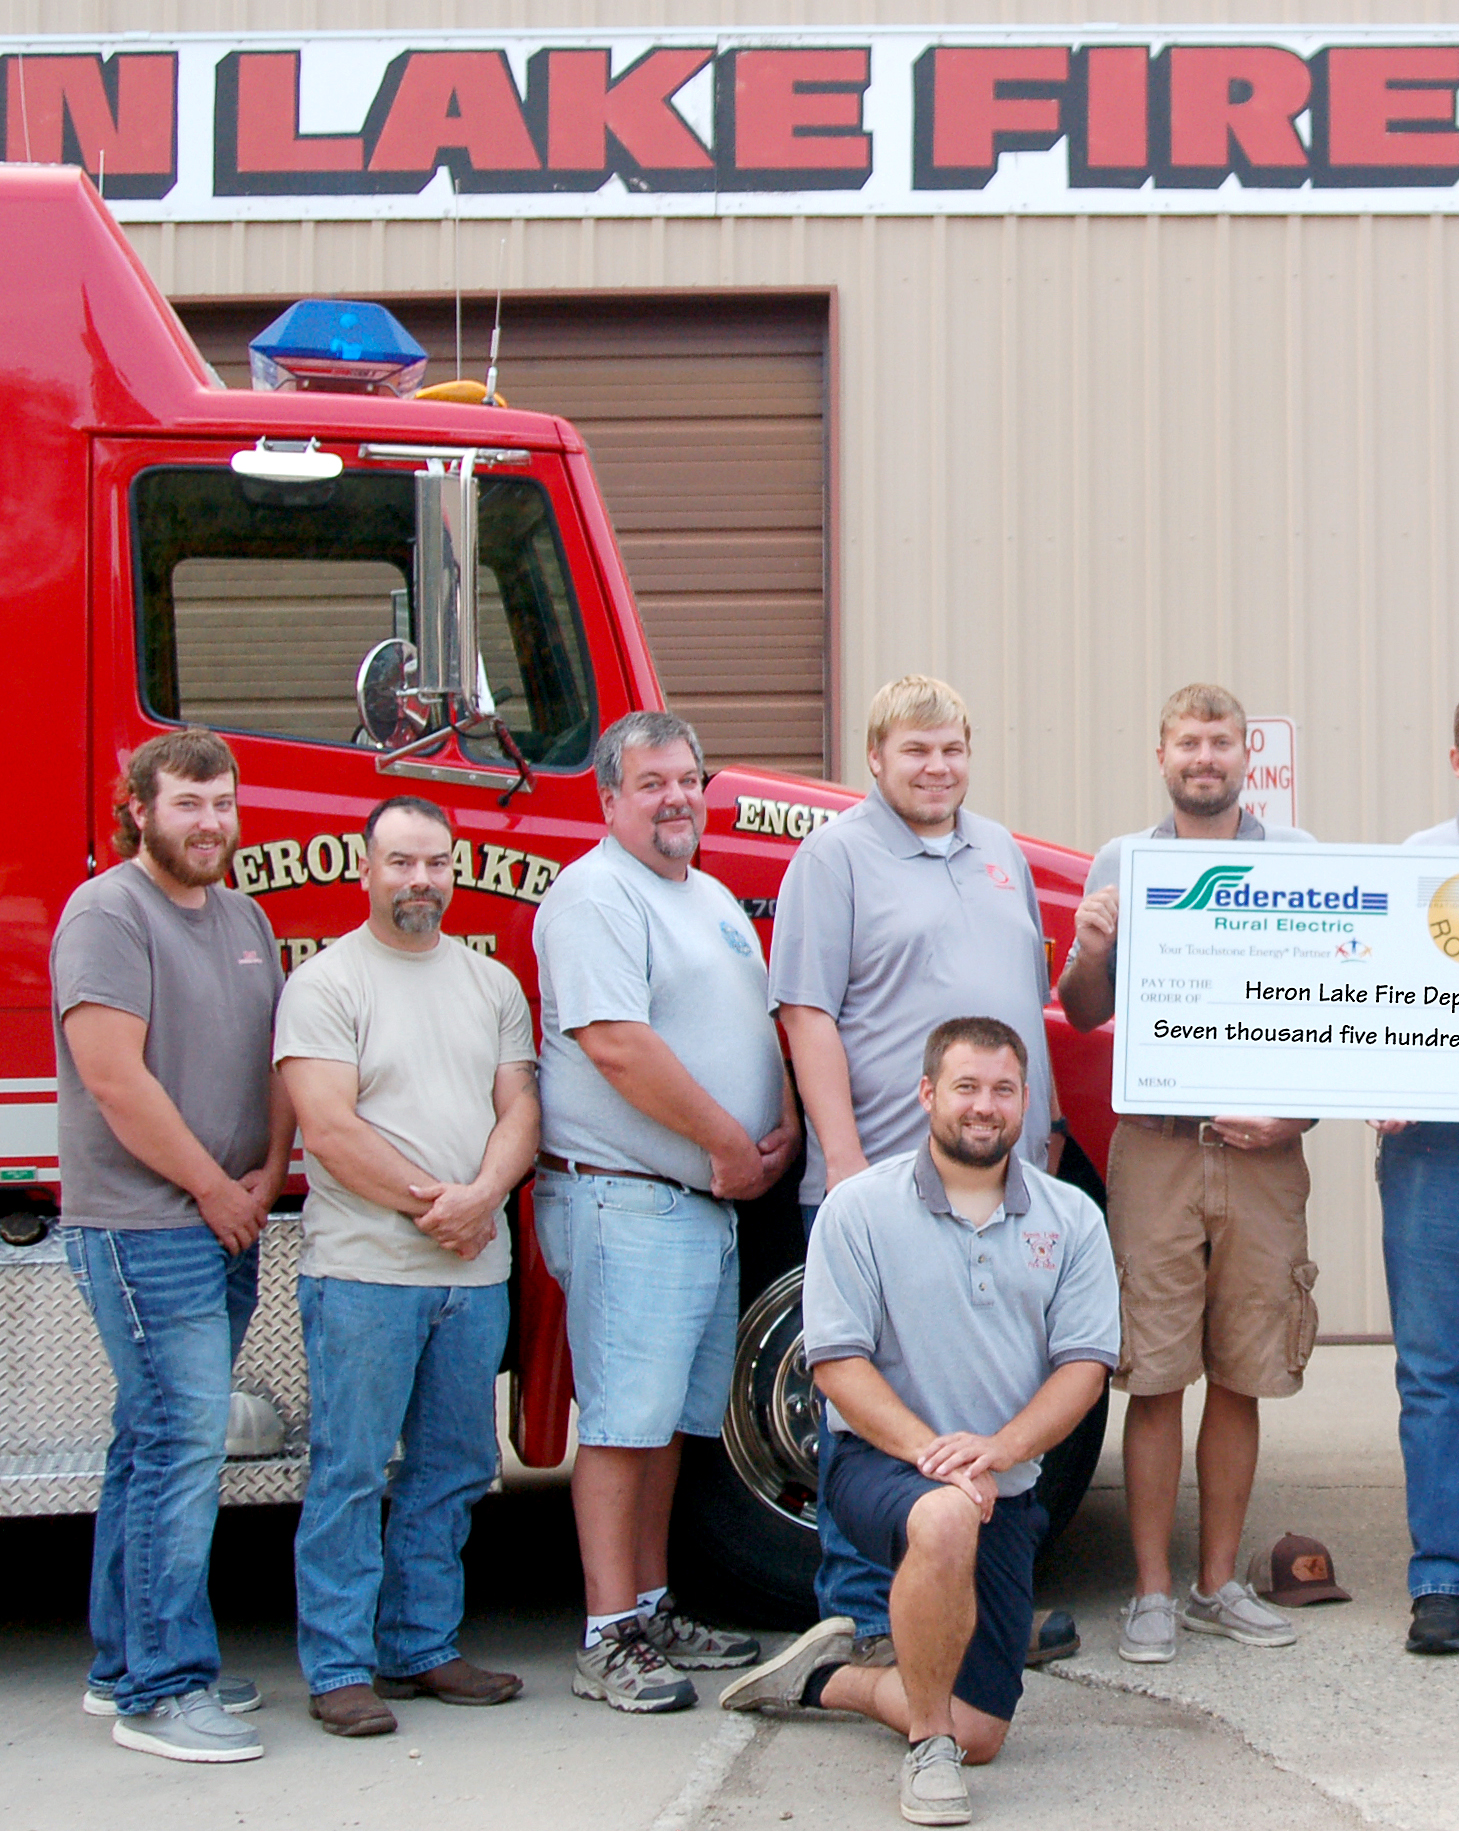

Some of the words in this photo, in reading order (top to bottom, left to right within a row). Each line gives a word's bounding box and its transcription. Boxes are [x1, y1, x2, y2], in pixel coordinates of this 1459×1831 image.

[213, 47, 872, 196] LAKE
[1242, 765, 1290, 791] KING
[734, 795, 842, 840] ENGI
[1244, 802, 1267, 818] NY
[220, 832, 367, 895] ERON
[451, 839, 561, 905] AKE
[1214, 917, 1268, 931] Rural
[1277, 918, 1354, 933] Electric
[1159, 943, 1182, 956] Your
[1186, 944, 1245, 956] Touchstone
[1293, 946, 1331, 958] Partner
[1141, 978, 1165, 989] PAY
[1168, 979, 1185, 989] TO
[1189, 980, 1212, 990] THE
[1246, 981, 1311, 1001] Heron
[1319, 983, 1368, 1003] Lake
[1376, 985, 1416, 1004] Fire
[1140, 993, 1181, 1004] ORDER
[1185, 994, 1201, 1004] OF
[1154, 1019, 1217, 1040] Seven
[1225, 1022, 1332, 1043] thousand
[1339, 1024, 1377, 1044] five
[1138, 1077, 1176, 1088] MEMO
